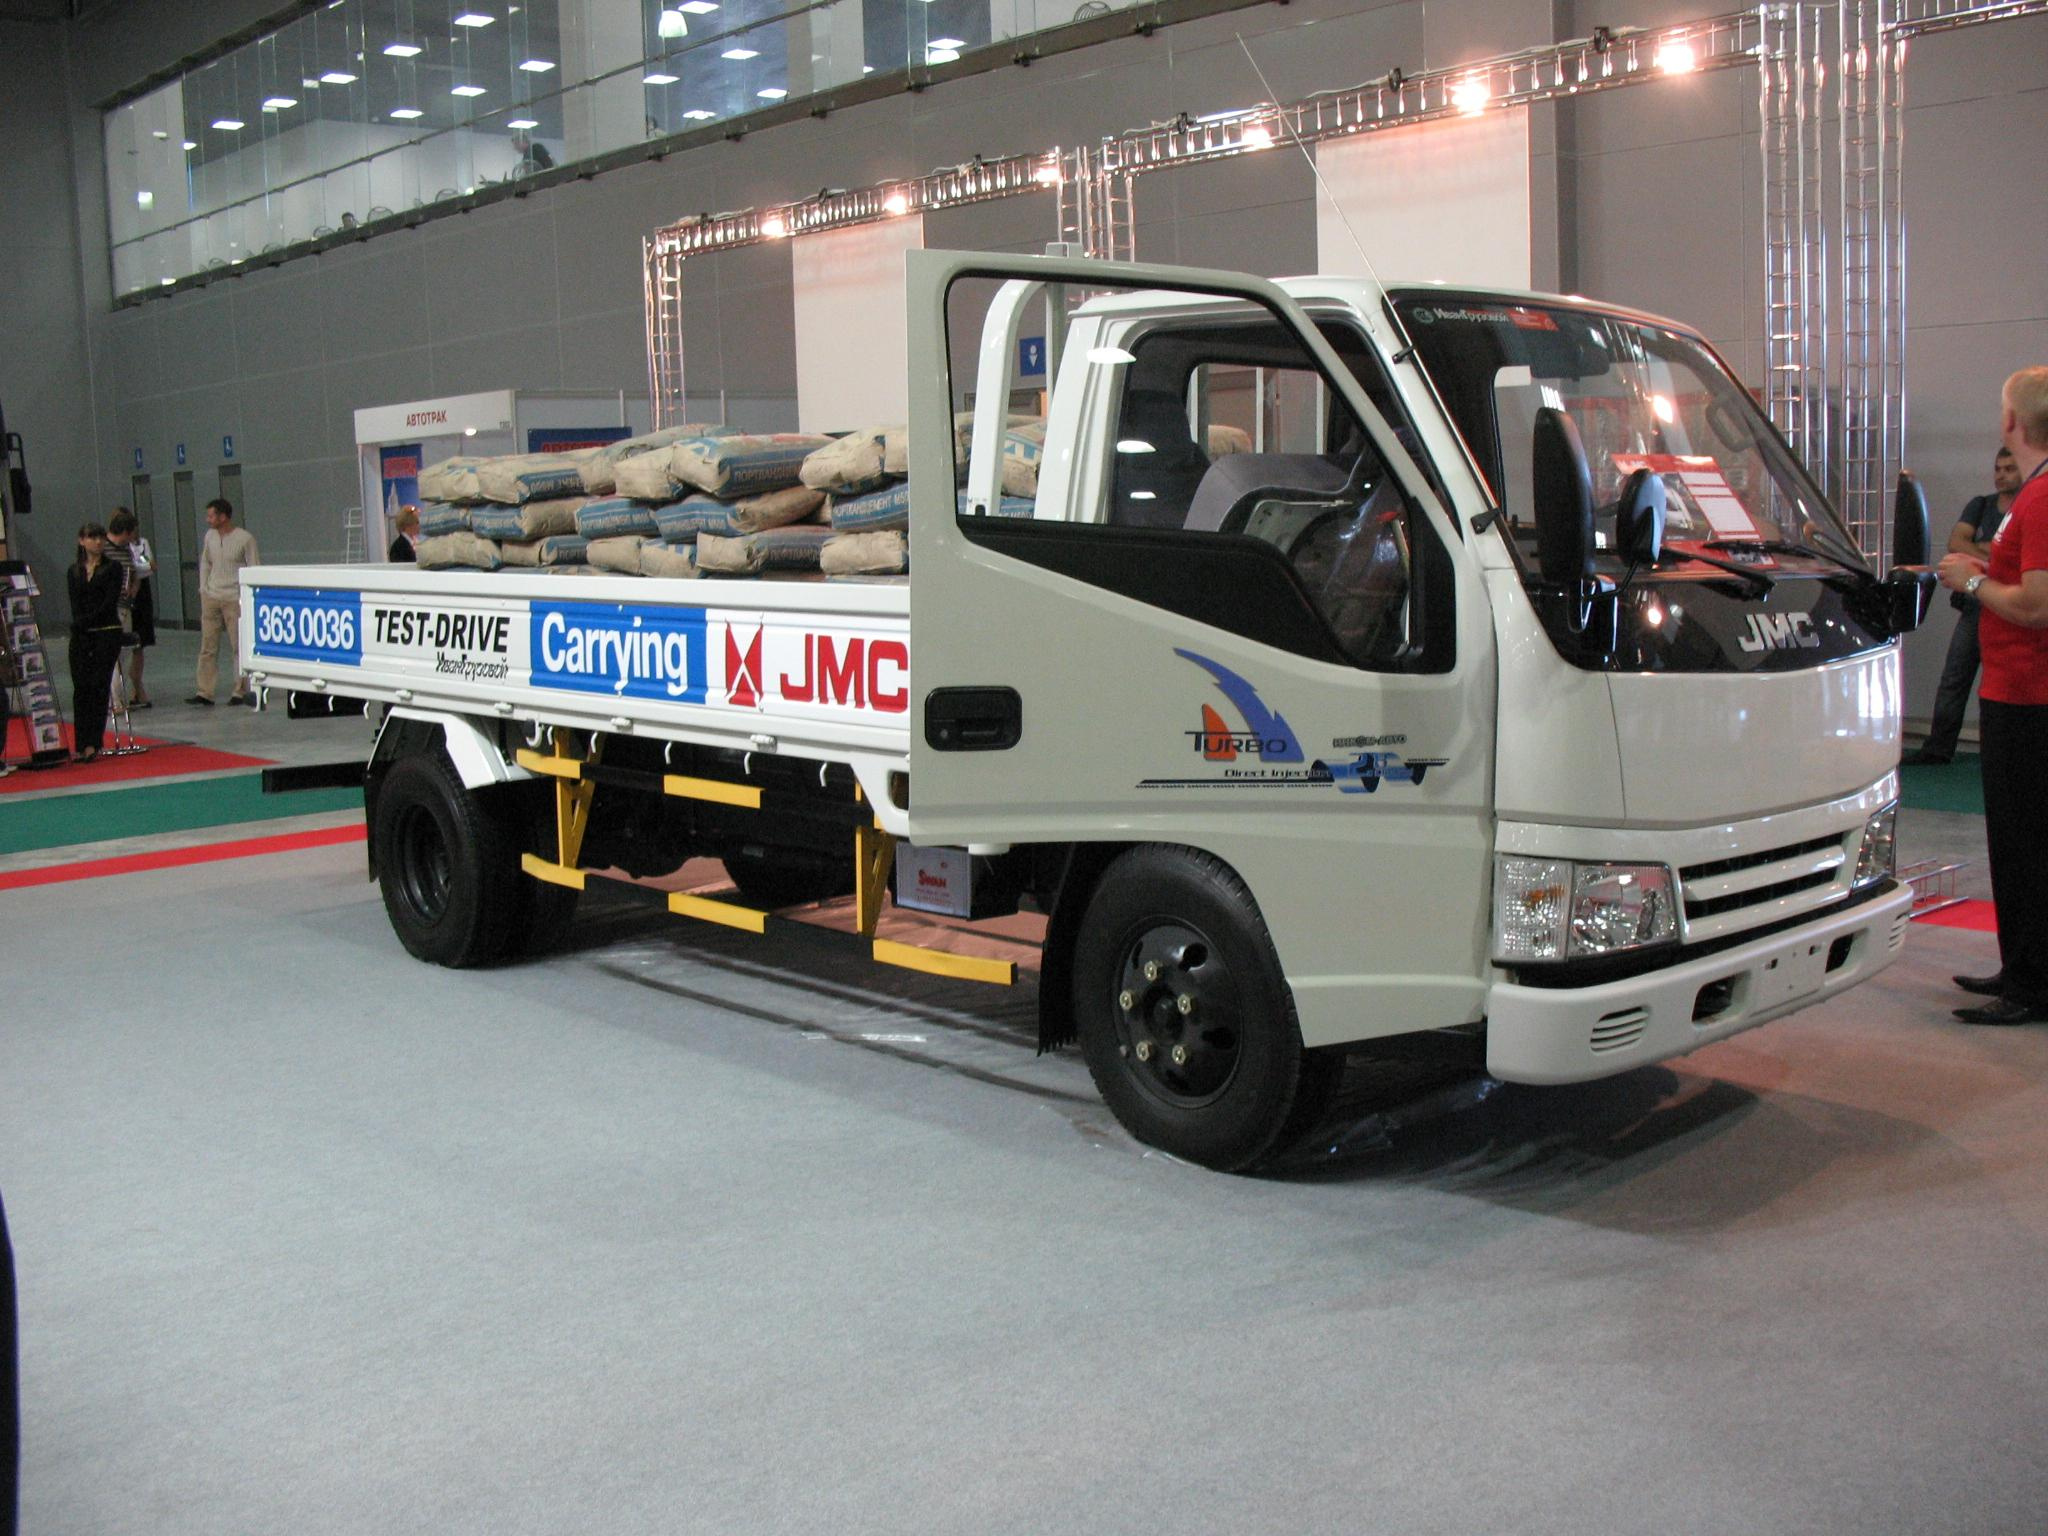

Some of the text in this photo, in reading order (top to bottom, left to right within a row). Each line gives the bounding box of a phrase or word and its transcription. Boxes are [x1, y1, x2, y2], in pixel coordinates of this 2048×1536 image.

[406, 410, 447, 426] АВТОТРАК
[258, 605, 355, 650] 363 0036
[374, 610, 511, 653] TEST-DRIVE
[1737, 612, 1820, 652] JMC
[541, 611, 688, 696] Carrying
[779, 633, 909, 713] JMC
[1224, 769, 1268, 778] Direct
